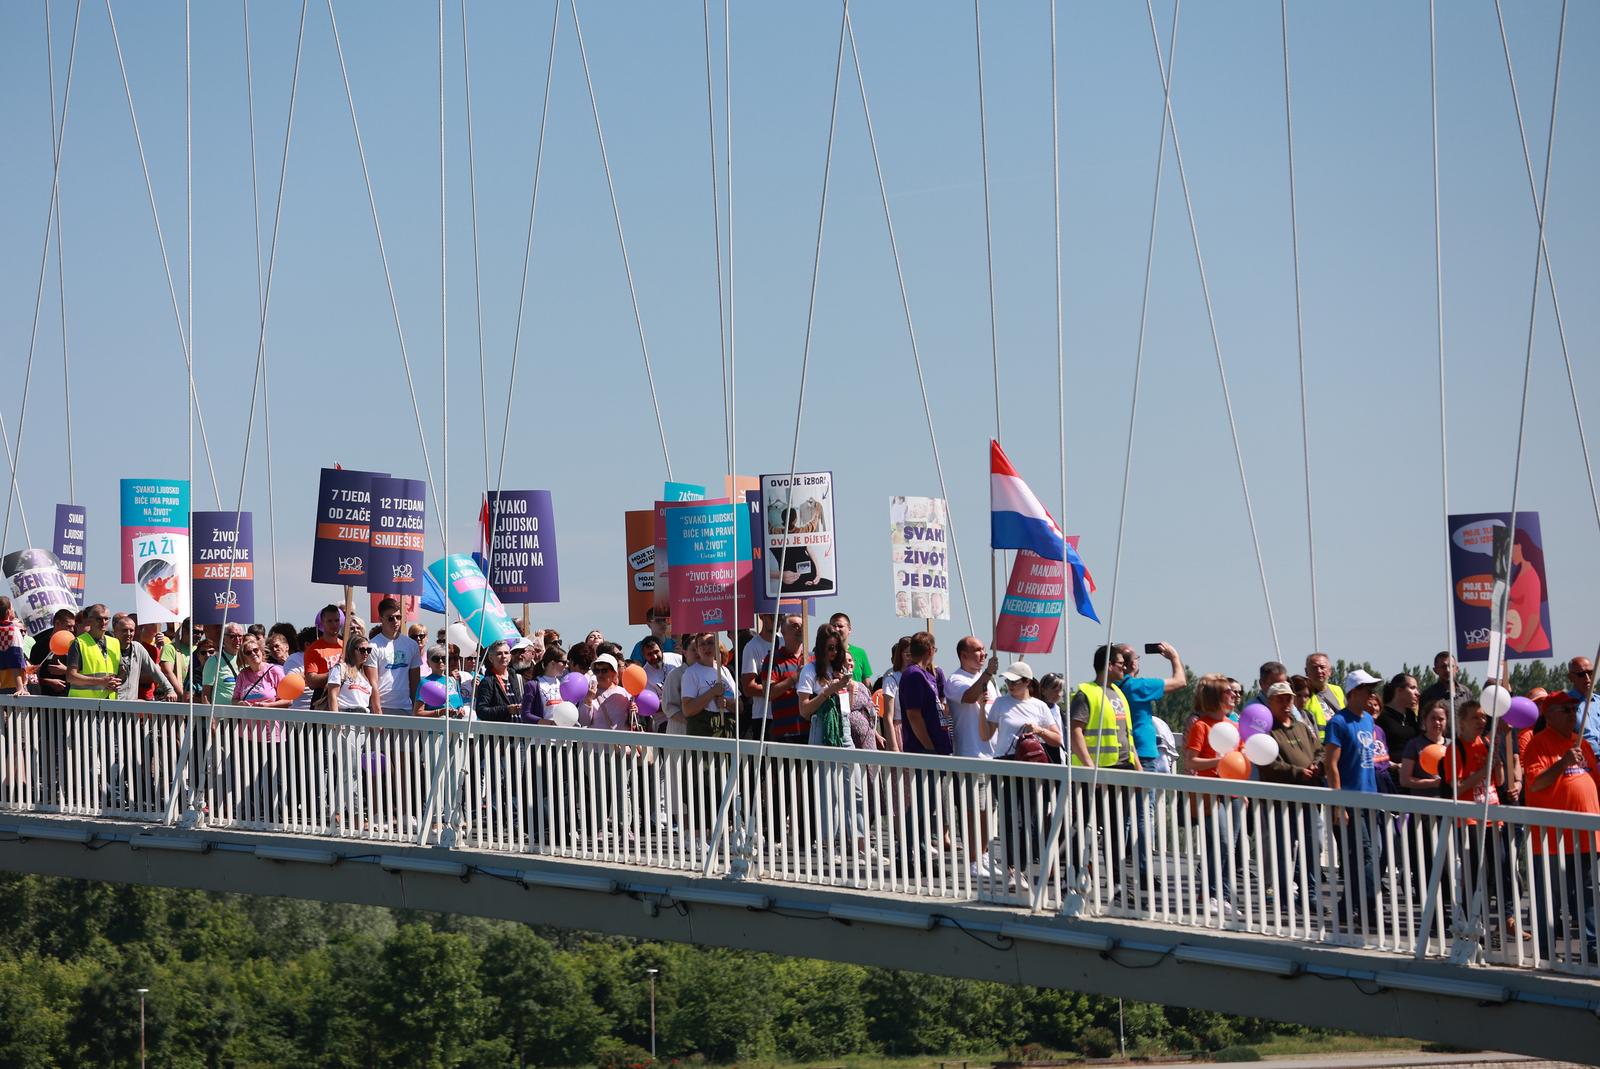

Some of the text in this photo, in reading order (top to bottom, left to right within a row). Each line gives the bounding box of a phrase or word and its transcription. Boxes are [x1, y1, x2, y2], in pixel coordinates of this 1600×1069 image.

[771, 479, 789, 487] OVO
[792, 477, 801, 486] JE
[332, 489, 338, 500] 7
[380, 498, 391, 509] 12
[493, 500, 527, 514] SVAKO
[329, 508, 343, 519] OD
[380, 516, 394, 527] OD
[212, 528, 240, 542] ŽIVOT
[701, 528, 714, 537] IMA
[375, 534, 411, 547] SMIJEŠI
[494, 532, 540, 549] BIĆE IMA
[694, 542, 704, 551] NA
[793, 537, 801, 545] JE
[139, 540, 157, 558] ZA
[494, 552, 544, 567] PRAVO NA
[631, 552, 646, 562] MOJE
[904, 546, 945, 566] ŽIVOT
[495, 568, 526, 585] ŽIVOT.
[902, 573, 947, 590] JE DAR
[1017, 581, 1024, 593] U
